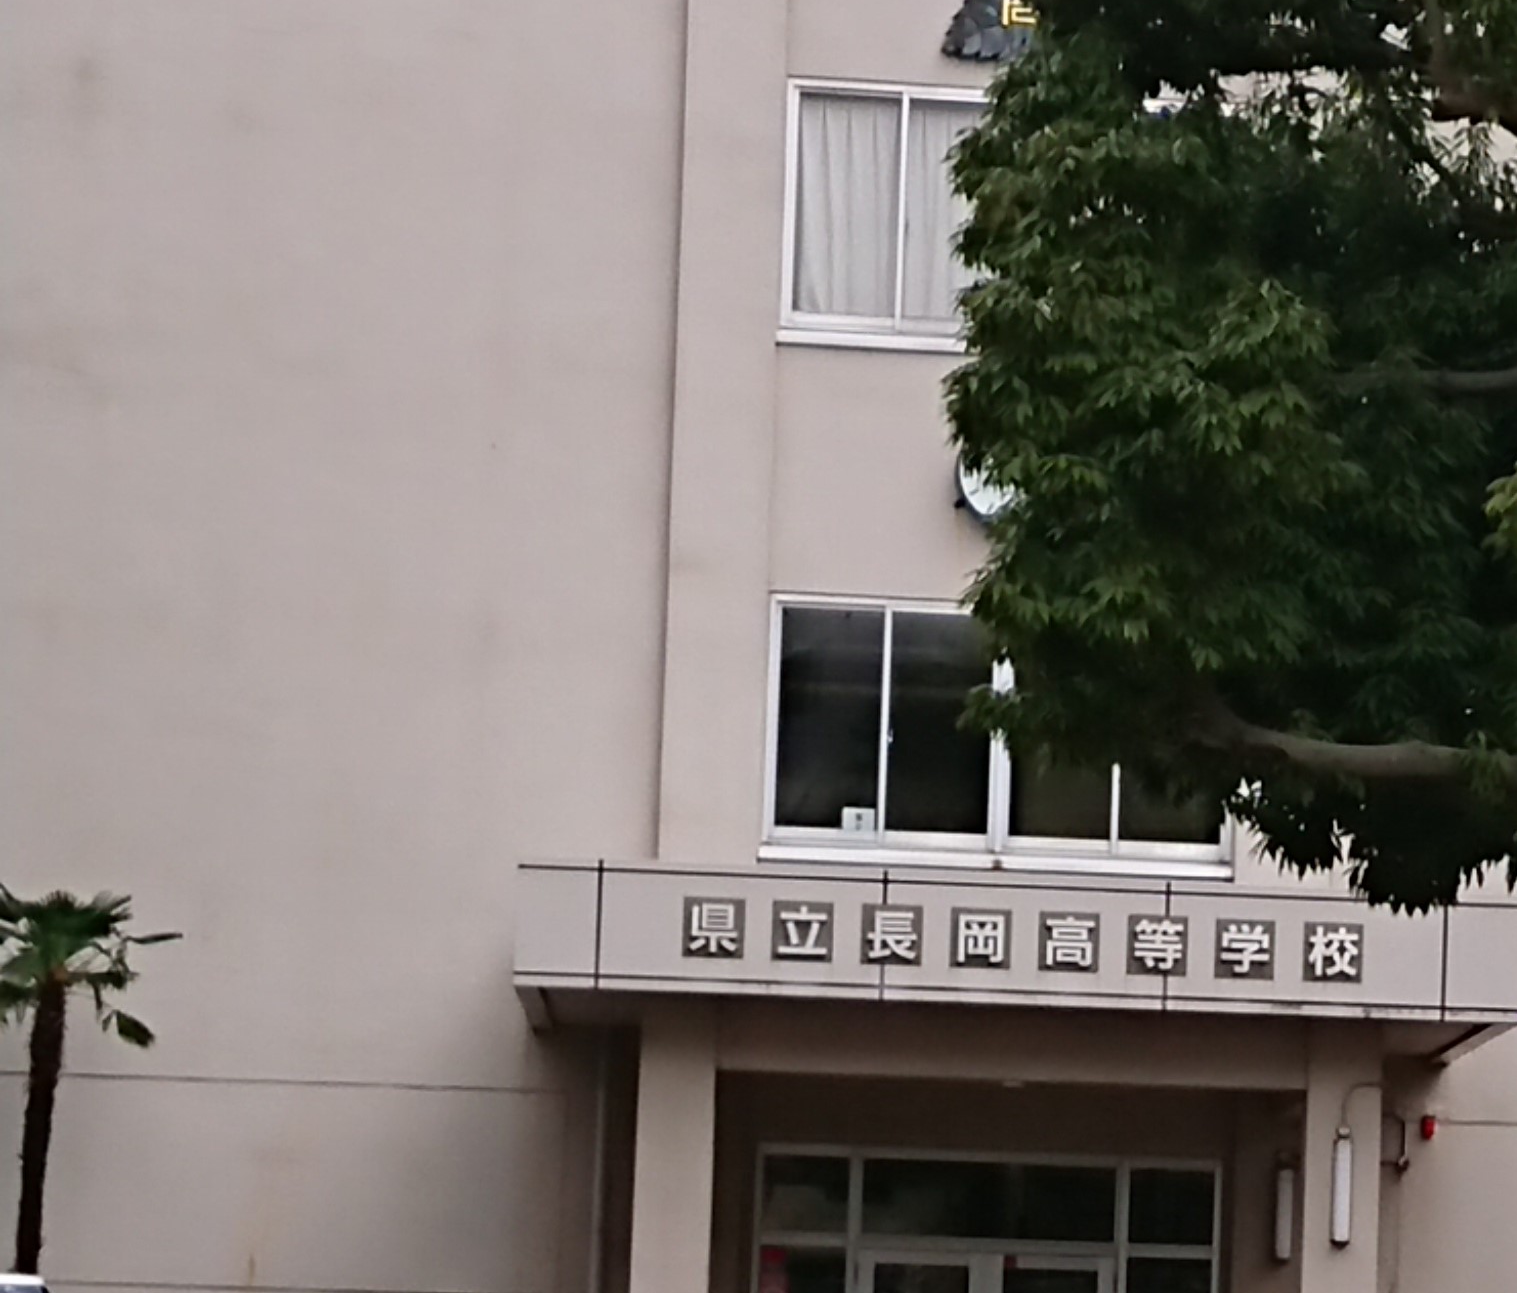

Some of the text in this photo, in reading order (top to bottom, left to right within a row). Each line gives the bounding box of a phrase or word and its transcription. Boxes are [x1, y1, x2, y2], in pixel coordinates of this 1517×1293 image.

[689, 902, 1359, 976] 県立長岡高等学校
